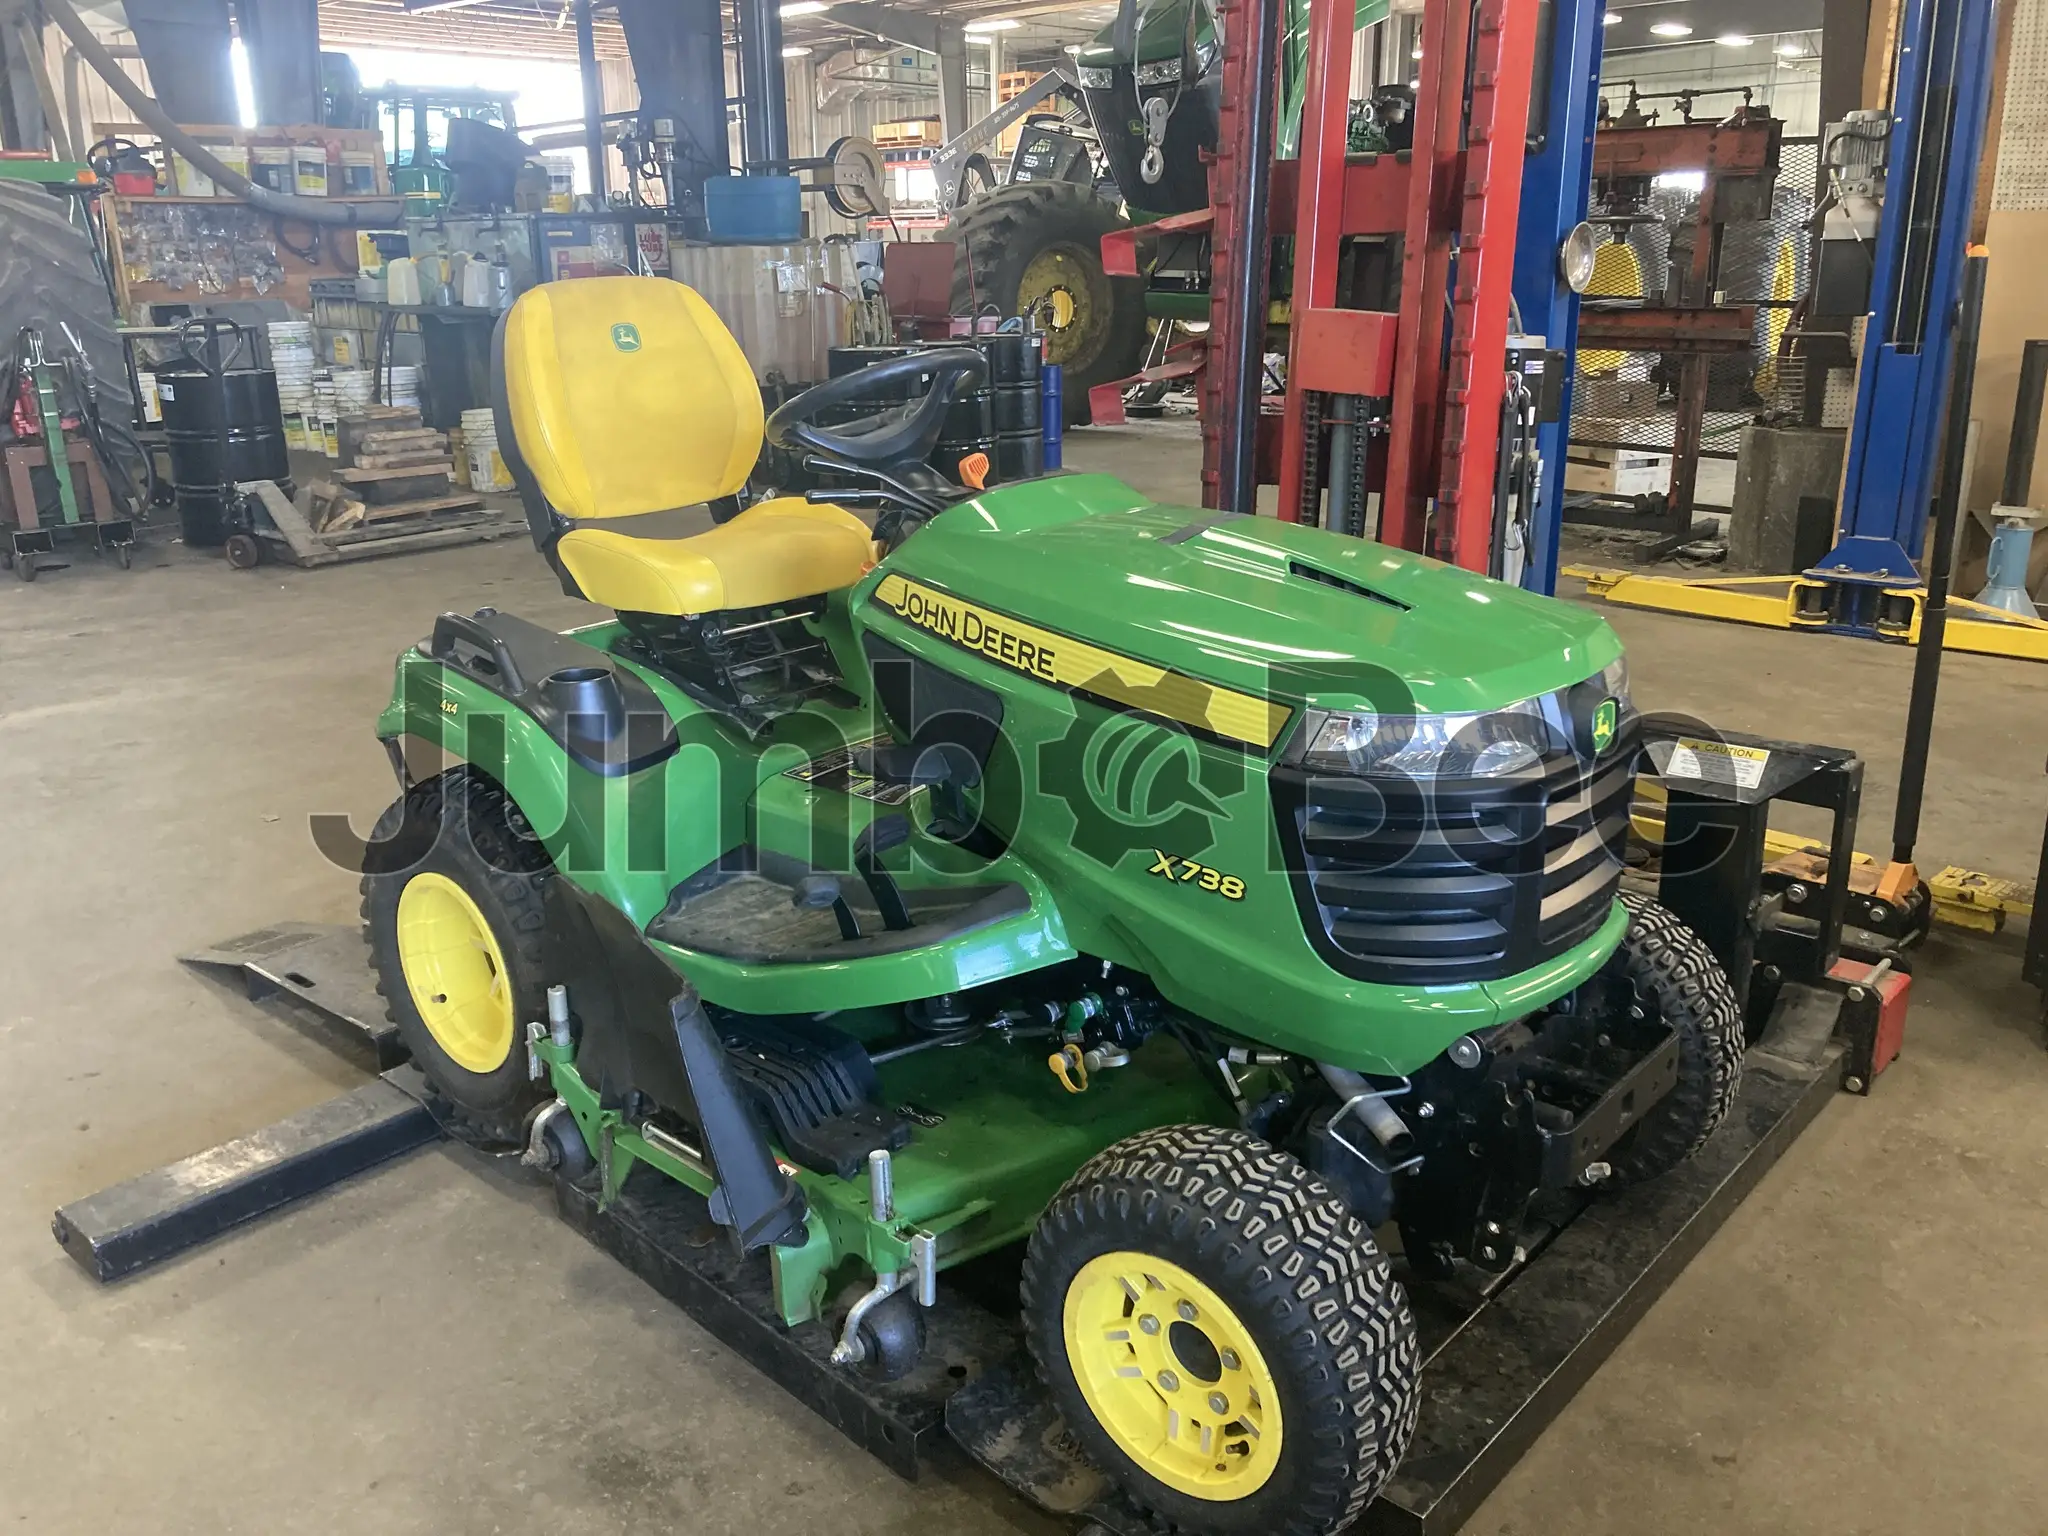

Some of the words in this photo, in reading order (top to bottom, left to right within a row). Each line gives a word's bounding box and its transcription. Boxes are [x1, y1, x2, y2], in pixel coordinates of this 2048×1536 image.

[895, 584, 957, 636] JOHN
[962, 610, 1056, 678] DEERE
[440, 699, 458, 715] 4x4
[1704, 743, 1754, 758] CAUTION
[1146, 847, 1247, 901] X738
